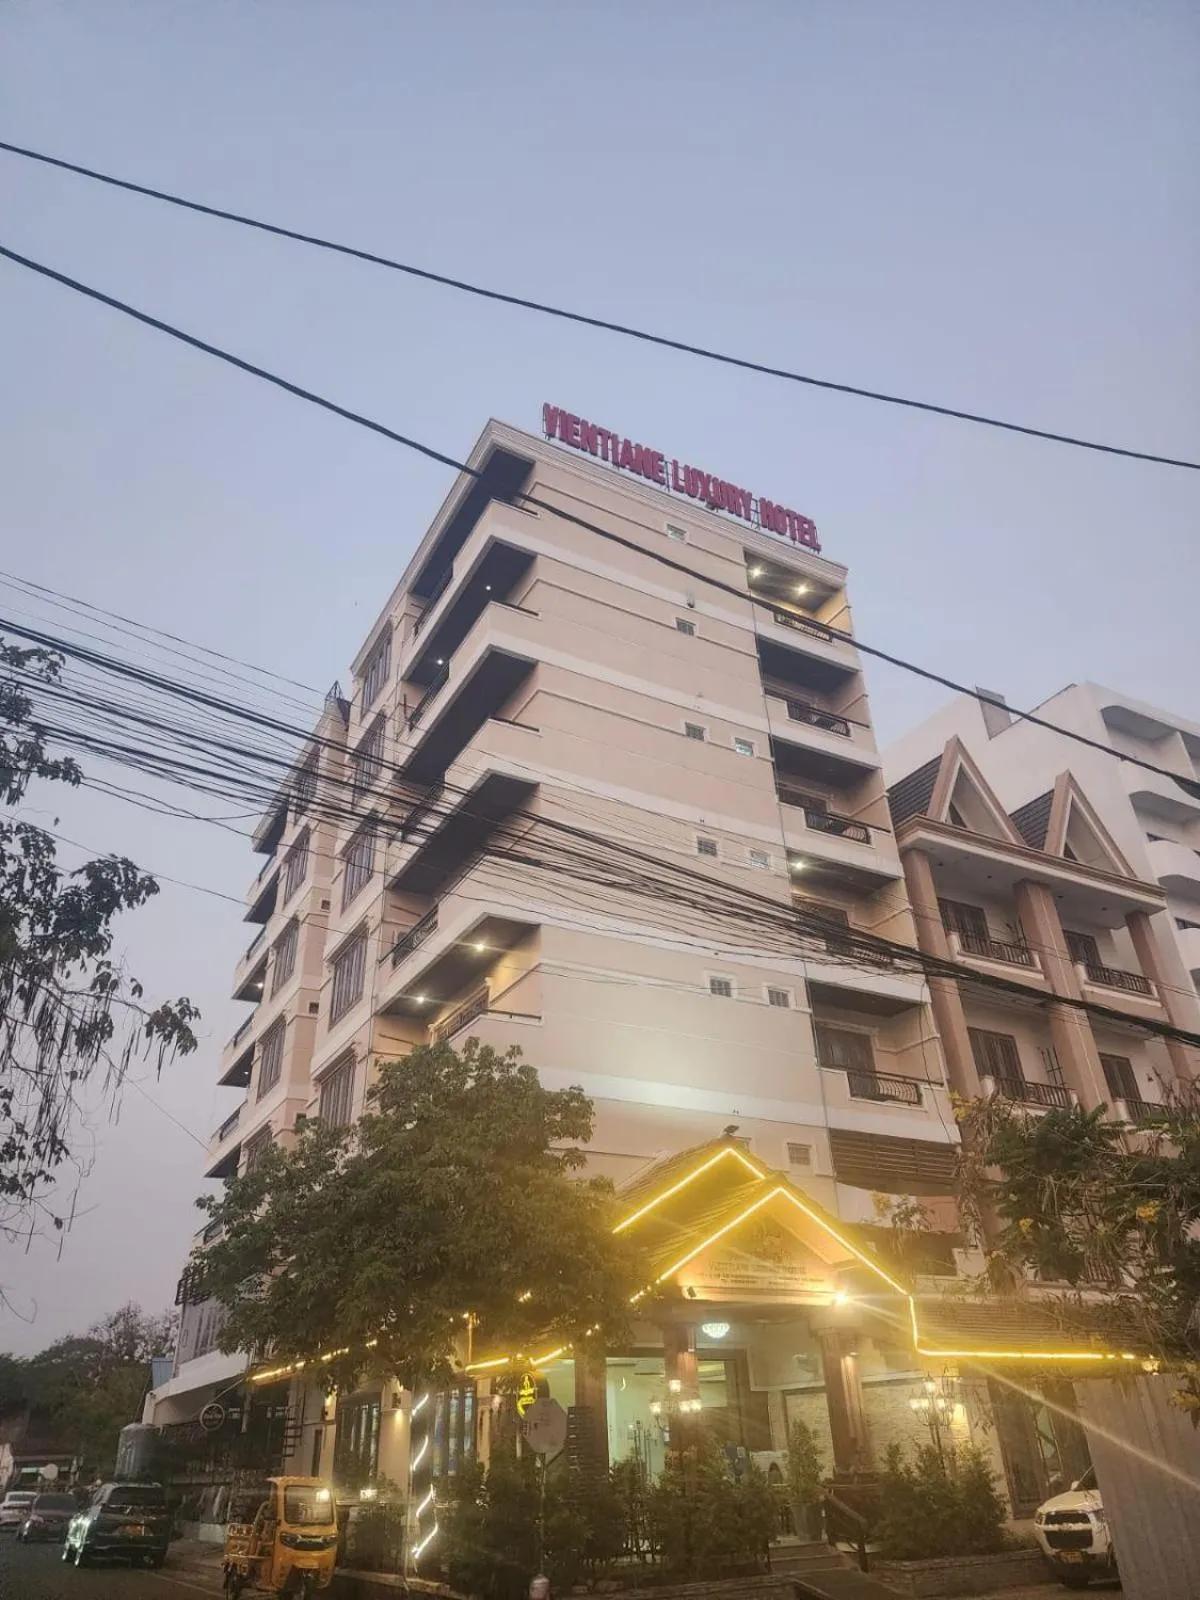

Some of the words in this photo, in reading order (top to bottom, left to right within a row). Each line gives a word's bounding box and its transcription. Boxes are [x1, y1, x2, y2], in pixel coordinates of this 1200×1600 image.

[543, 402, 666, 486] VIENTIANE
[672, 459, 753, 522] LUXURY
[759, 497, 821, 551] HOTEL
